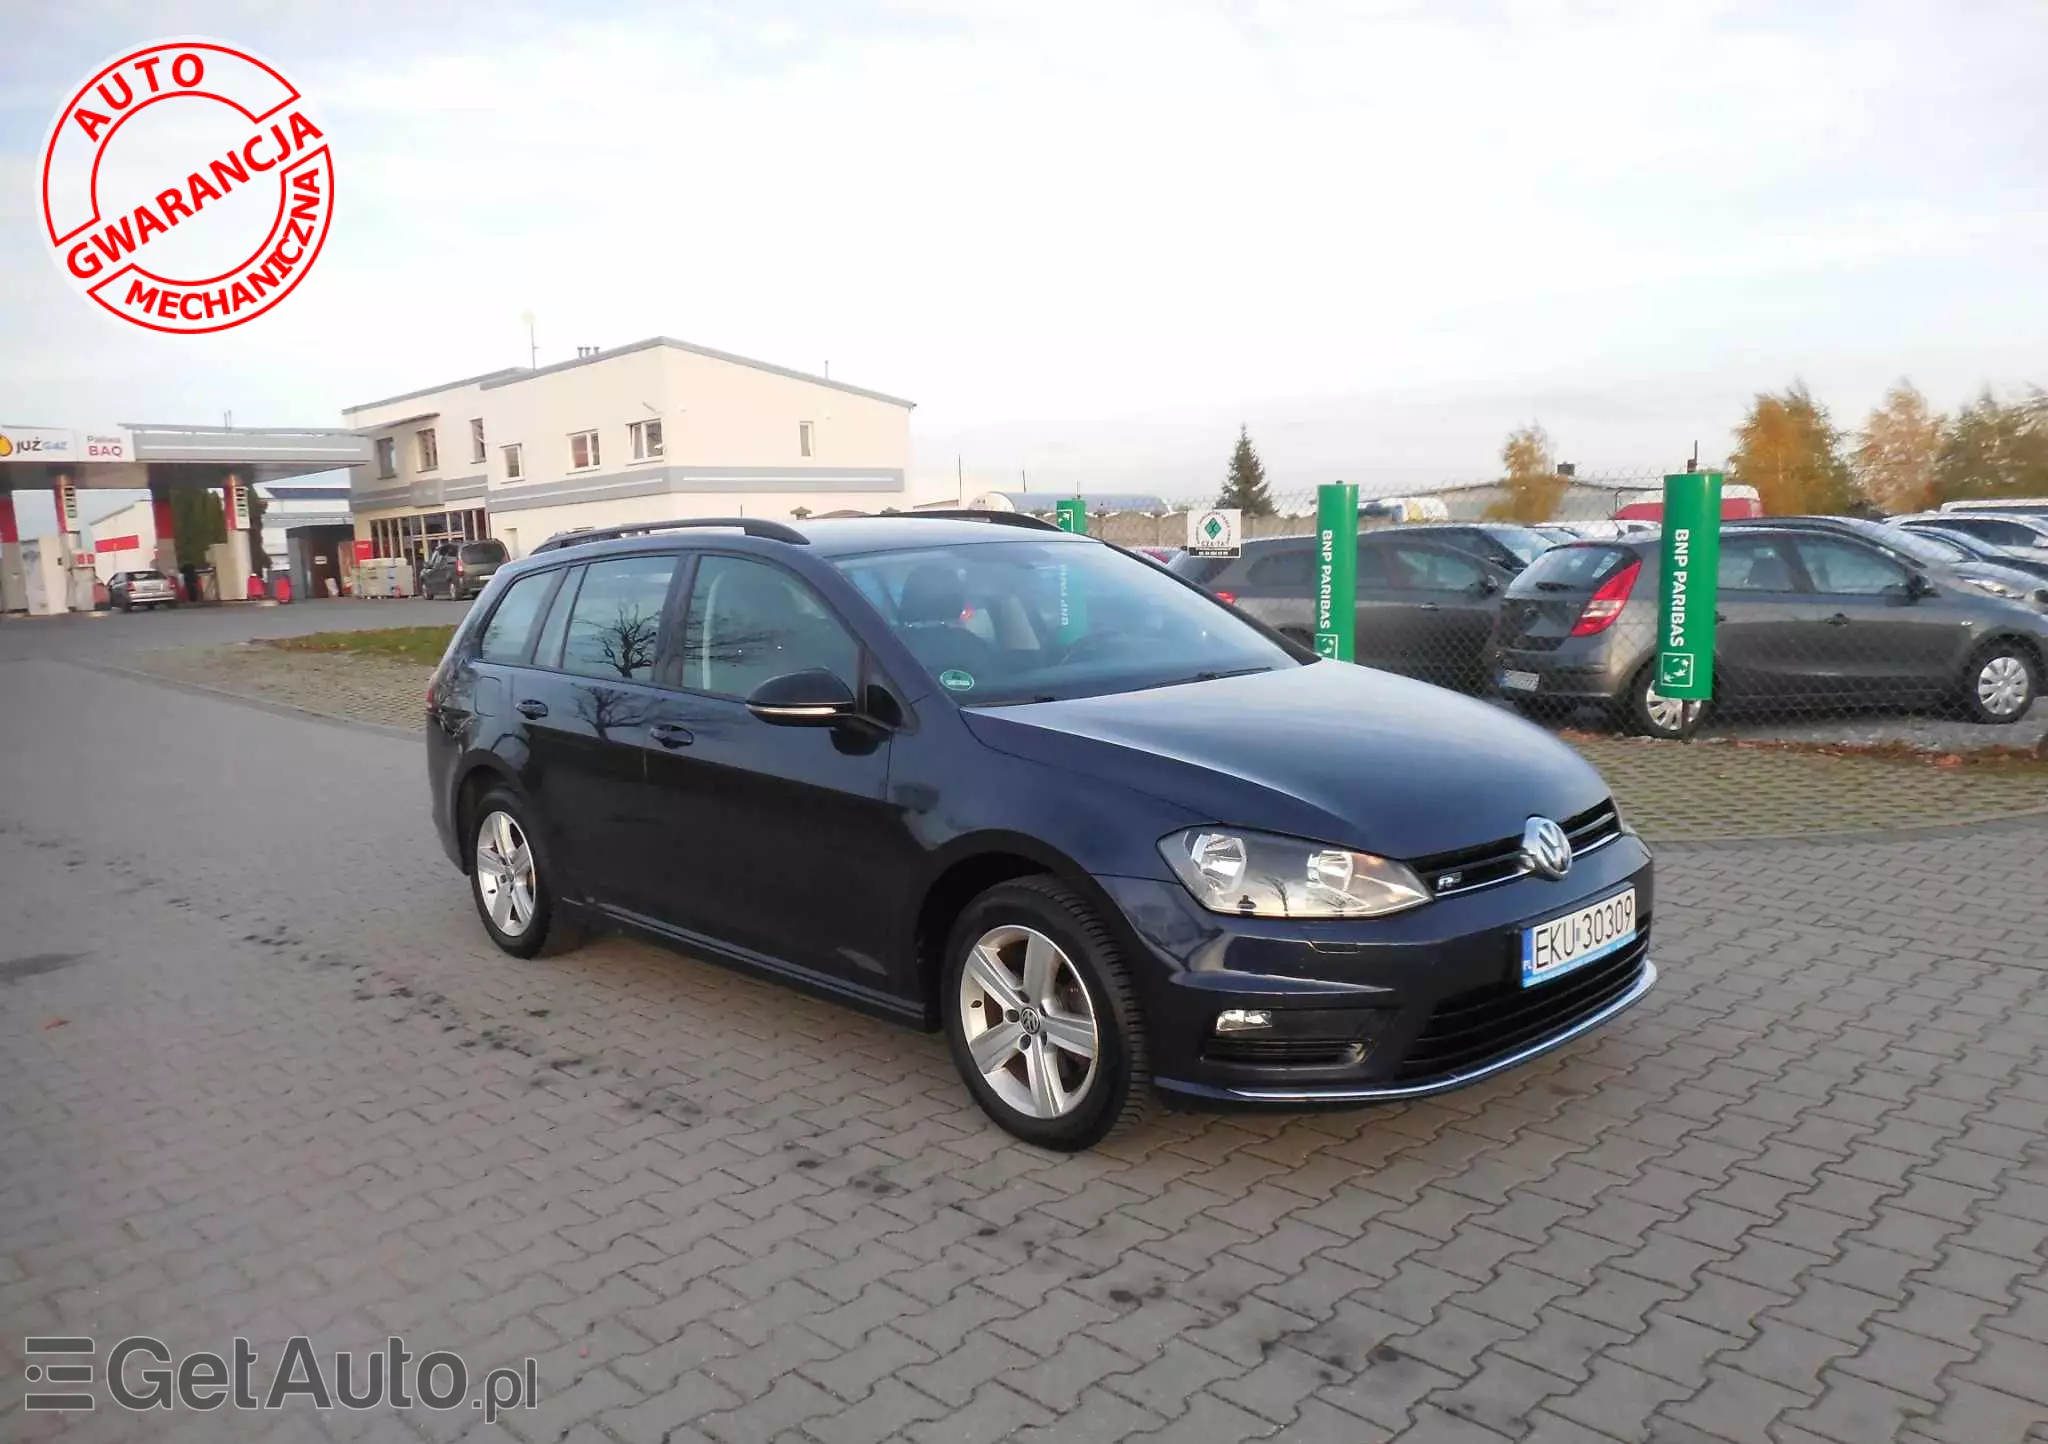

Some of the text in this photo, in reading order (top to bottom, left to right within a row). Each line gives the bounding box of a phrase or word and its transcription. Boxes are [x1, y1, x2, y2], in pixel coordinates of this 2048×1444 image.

[1320, 529, 1333, 629] BNP PARIBAS
[1669, 529, 1690, 647] BNP PARIBAS
[1535, 895, 1633, 968] EKU 30309
